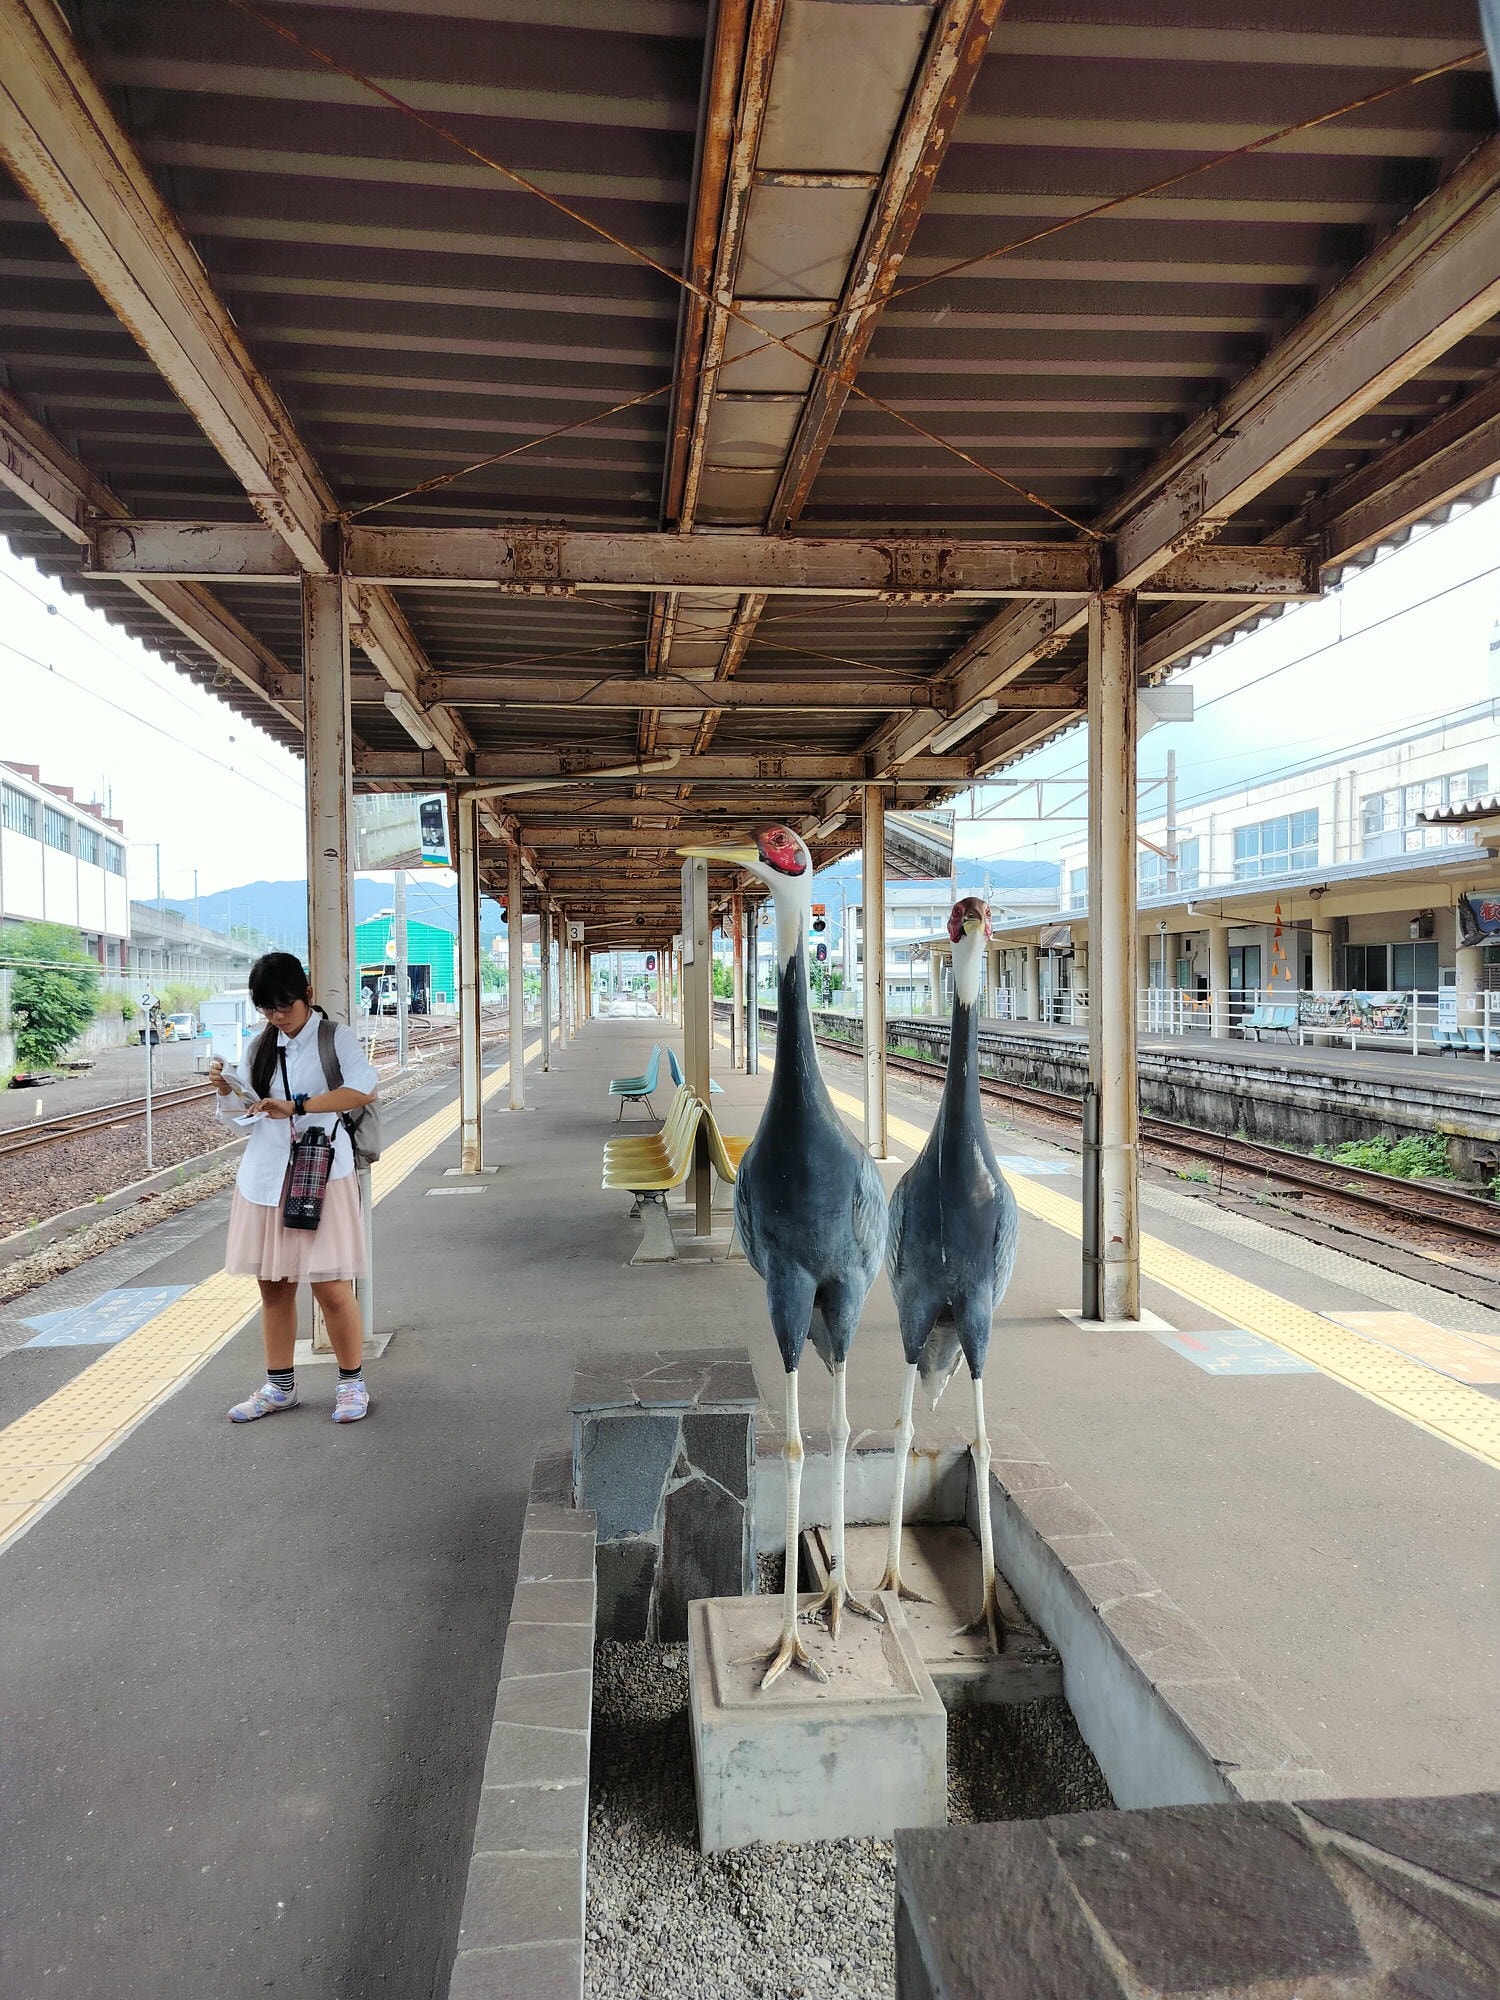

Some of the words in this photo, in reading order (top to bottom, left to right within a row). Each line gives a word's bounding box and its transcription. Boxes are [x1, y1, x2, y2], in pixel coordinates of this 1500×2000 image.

[761, 915, 769, 925] 2
[1160, 921, 1167, 930] 2
[570, 927, 579, 939] 3
[142, 993, 151, 1006] 2
